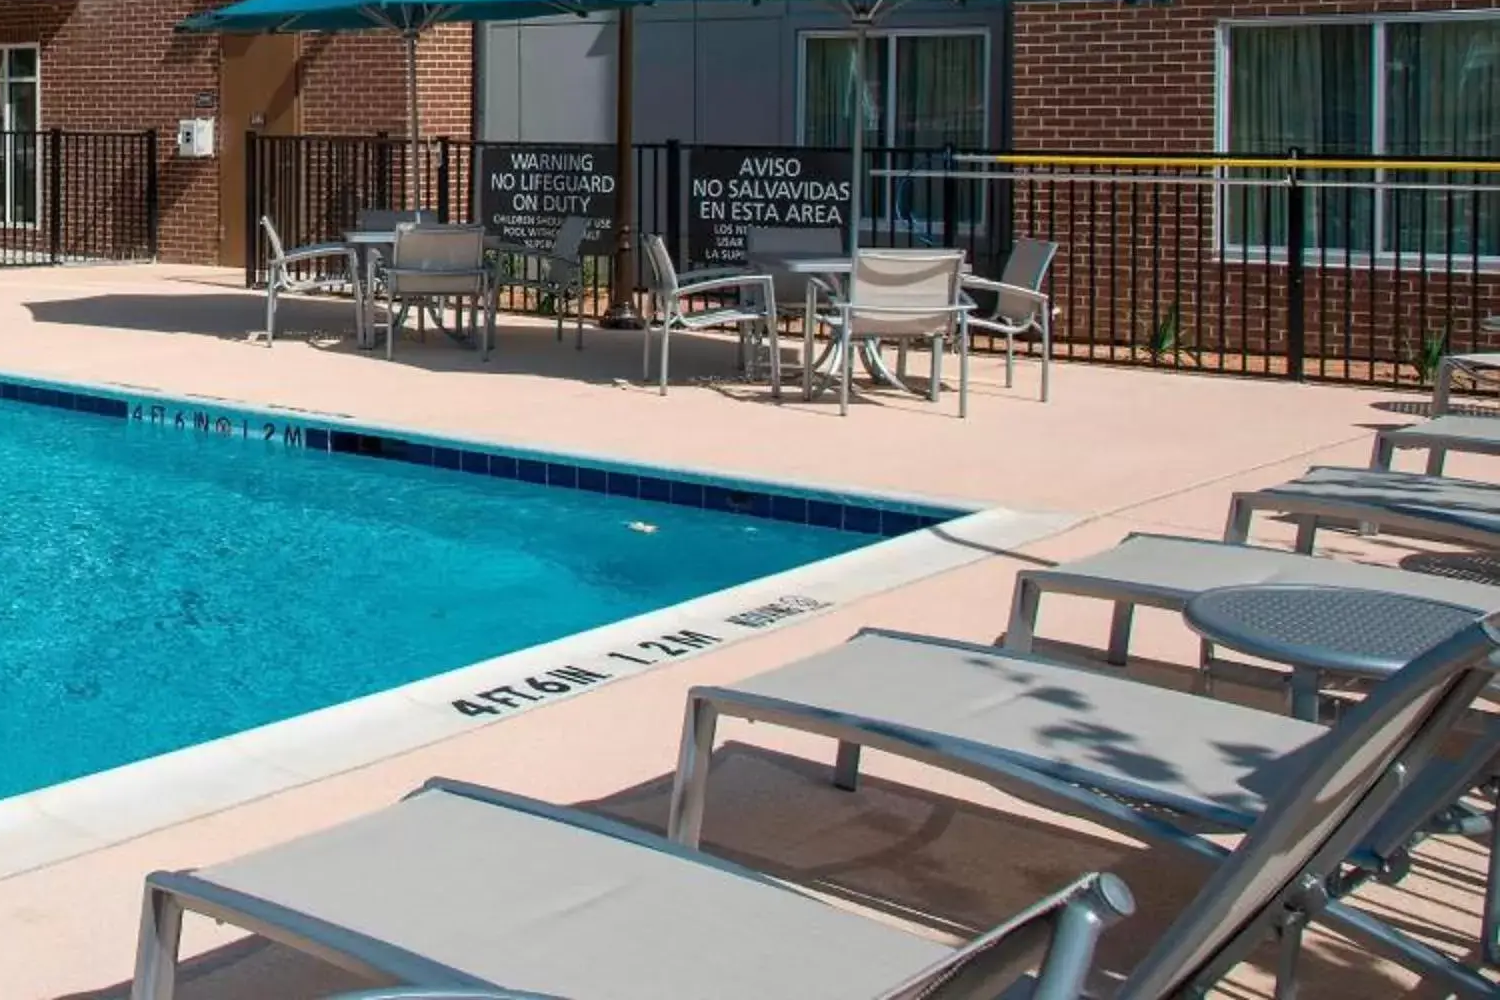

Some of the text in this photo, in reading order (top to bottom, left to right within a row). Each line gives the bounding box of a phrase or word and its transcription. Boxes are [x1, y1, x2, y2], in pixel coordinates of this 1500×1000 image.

[511, 153, 593, 171] WARNING
[739, 158, 801, 177] AVISO
[491, 173, 615, 193] NO LIFEGUARD
[693, 179, 850, 200] NO SALVAVIDAS
[513, 193, 591, 213] ON DUTY
[700, 201, 842, 223] EN ESTA AREA
[493, 213, 535, 225] CHILDREN
[503, 226, 528, 237] POOL
[713, 224, 733, 235] LOS
[705, 248, 719, 259] LA
